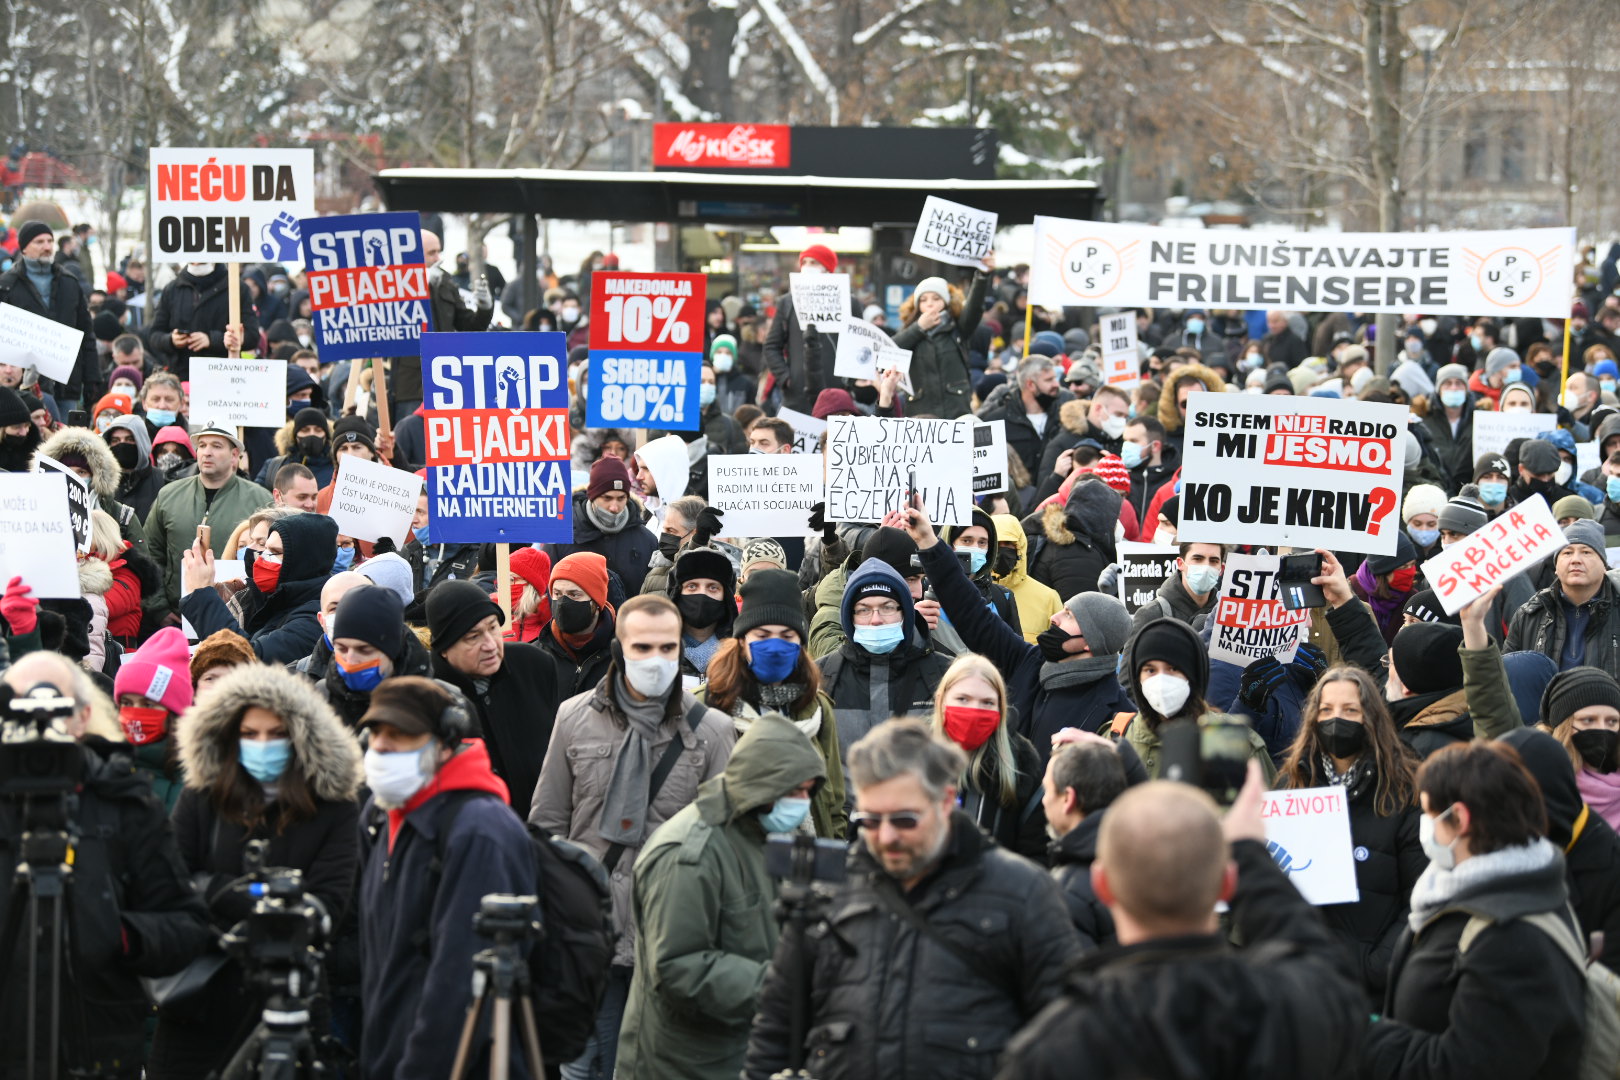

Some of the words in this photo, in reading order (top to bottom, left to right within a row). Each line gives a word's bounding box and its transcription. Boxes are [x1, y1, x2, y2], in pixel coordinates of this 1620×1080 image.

[157, 157, 246, 202] NEĆU
[252, 165, 297, 201] DA
[931, 208, 972, 229] NAŠI
[158, 215, 251, 254] ODEM
[924, 229, 989, 256] LUTATI
[309, 227, 417, 272] STOP
[1151, 240, 1196, 264] NE
[1209, 240, 1450, 268] UNIŠTAVAJTE
[605, 278, 693, 297] MAKEDONIJA
[1149, 271, 1448, 306] FRILENSERE
[320, 300, 428, 330] RADNIKA
[604, 295, 690, 344] 10%
[323, 329, 343, 345] NA
[208, 363, 242, 372] DRŽAVNI
[244, 365, 269, 373] POREZ
[601, 358, 687, 386] SRBIJA
[431, 355, 560, 410] STOP
[208, 399, 242, 408] DRŽAVNI
[600, 385, 686, 422] 80%!
[832, 420, 859, 444] ZA
[876, 418, 966, 444] STRANCE
[1195, 411, 1271, 430] SISTEM
[1277, 415, 1324, 434] NIJE
[1329, 419, 1398, 439] RADIO
[831, 444, 934, 467] SUBVENCIJA
[1216, 433, 1257, 459] MI
[1266, 435, 1392, 470] JESMO.
[436, 462, 567, 496] RADNIKA
[716, 467, 759, 477] PUSTITE
[762, 466, 780, 476] ME
[783, 466, 798, 476] DA
[830, 466, 860, 489] ZA
[342, 486, 358, 498] ČIST
[359, 491, 389, 508] VAZDUH
[344, 473, 368, 485] KOLIKI
[369, 480, 376, 489] JE
[378, 483, 400, 495] POREZ
[401, 490, 410, 499] ZA
[717, 484, 753, 493] RADIM
[756, 484, 768, 493] ILI
[771, 482, 797, 493] ĆETE
[799, 483, 813, 493] MI
[339, 501, 366, 516] VODU?
[437, 497, 462, 518] NA
[464, 494, 565, 520] INTERNETU!
[717, 499, 760, 511] PLAĆATI
[1183, 482, 1232, 523] KO
[1237, 485, 1281, 525] JE
[1285, 486, 1397, 537] KRIV?
[1123, 559, 1162, 577] Zarada
[1218, 639, 1233, 652] NA
[1220, 624, 1298, 647] RADNIKA
[1260, 800, 1281, 818] ZA
[1285, 793, 1342, 816] ŽIVOT!
